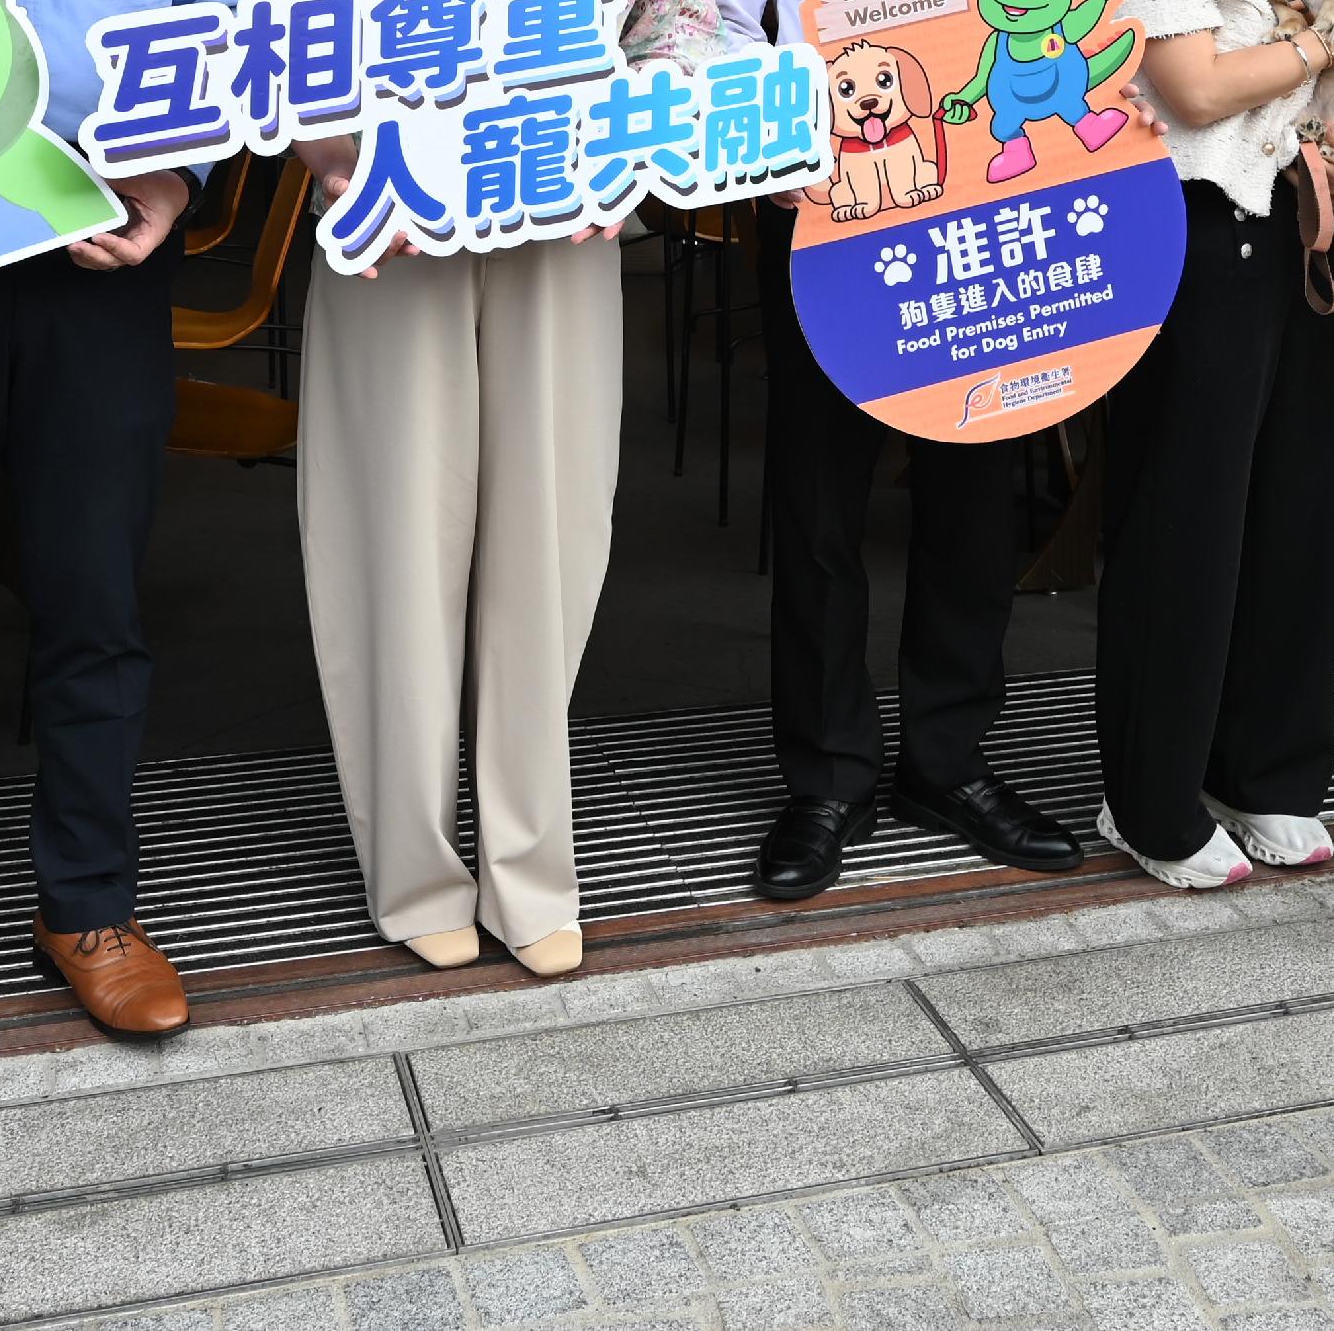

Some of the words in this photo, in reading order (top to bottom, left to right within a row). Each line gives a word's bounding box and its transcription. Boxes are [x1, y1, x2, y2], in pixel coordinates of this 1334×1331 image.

[332, 50, 817, 252] 人寵共融
[927, 202, 1056, 285] 准許
[896, 329, 942, 355] Food
[945, 311, 1025, 342] Premises
[1029, 283, 1114, 320] Permitted
[898, 253, 1104, 331] 狗隻進入的食肆
[950, 346, 978, 361] for
[981, 333, 1018, 354] Dog
[1022, 320, 1068, 343] Entry
[1001, 393, 1017, 402] Food
